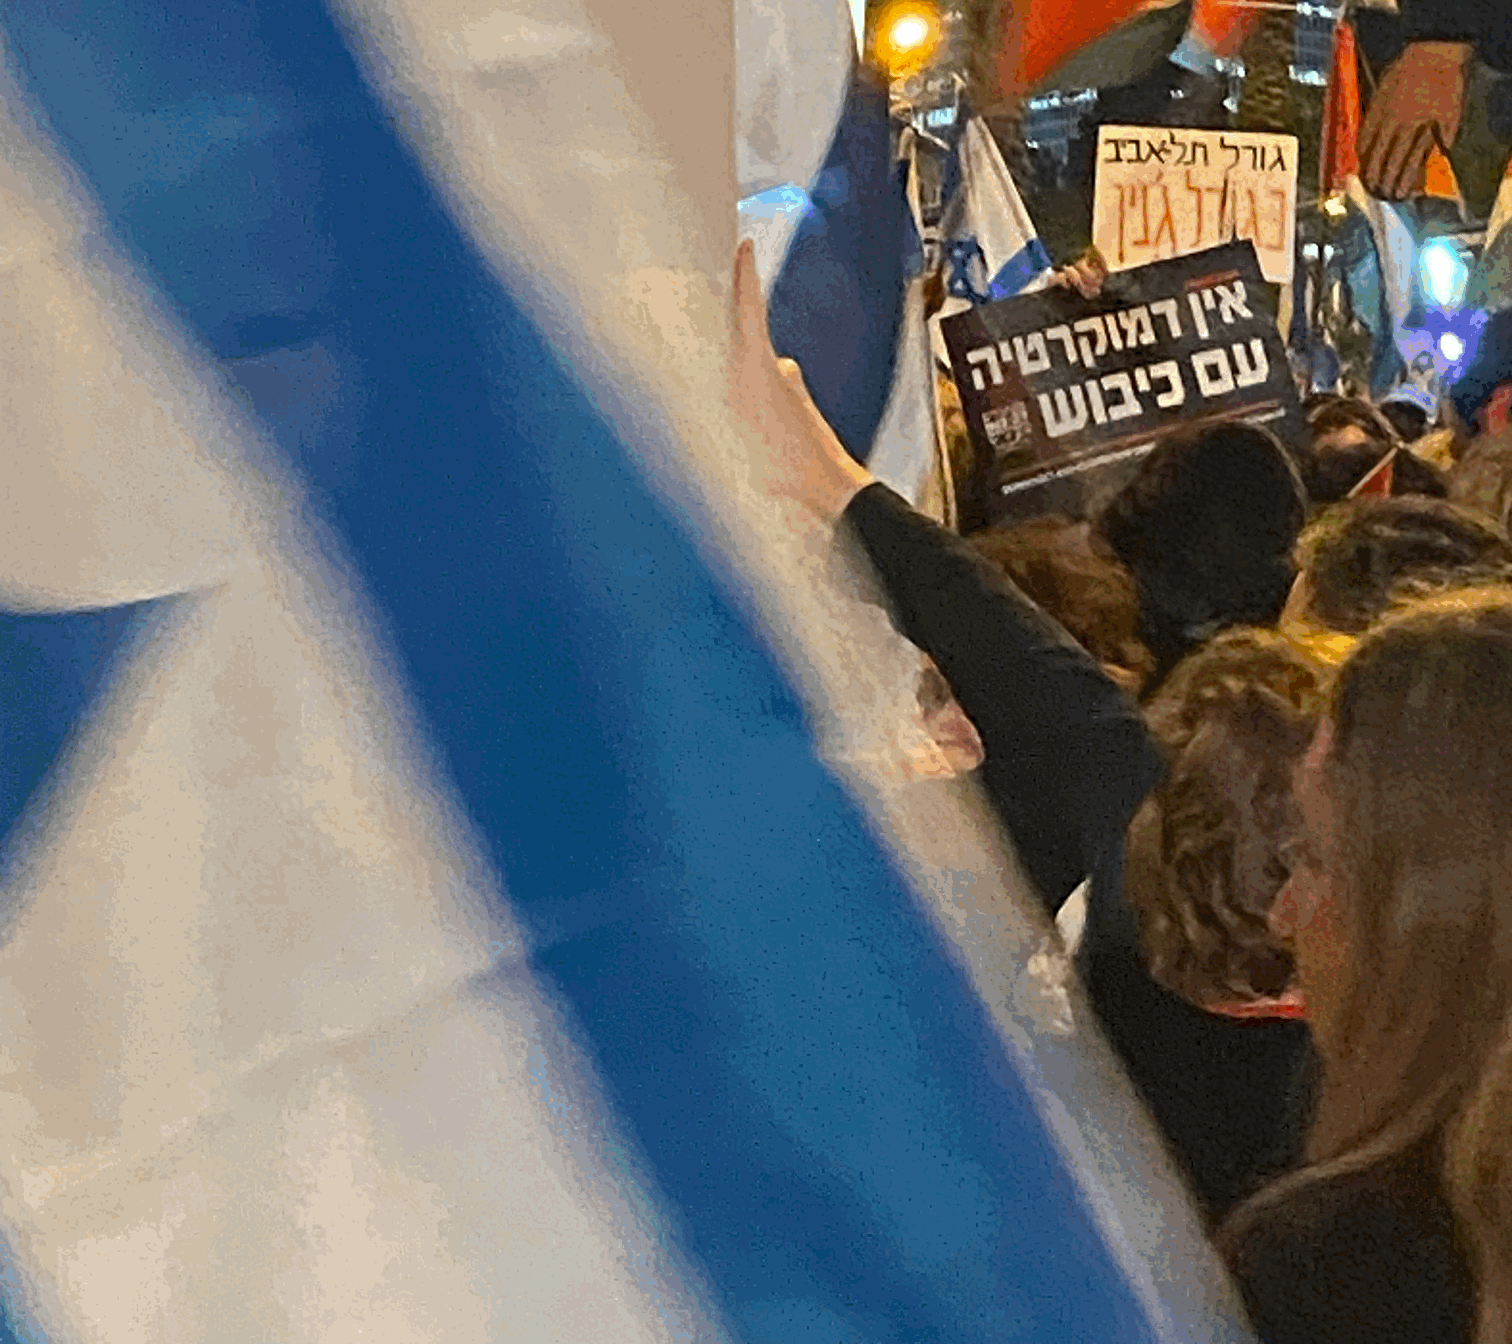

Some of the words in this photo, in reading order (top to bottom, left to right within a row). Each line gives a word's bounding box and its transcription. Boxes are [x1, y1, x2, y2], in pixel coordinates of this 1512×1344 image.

[1220, 136, 1286, 172] גורל
[1187, 280, 1253, 339] אין
[966, 298, 1183, 391] דמוקרטיה
[1190, 338, 1269, 398] עם
[1037, 360, 1186, 438] כיבוש
